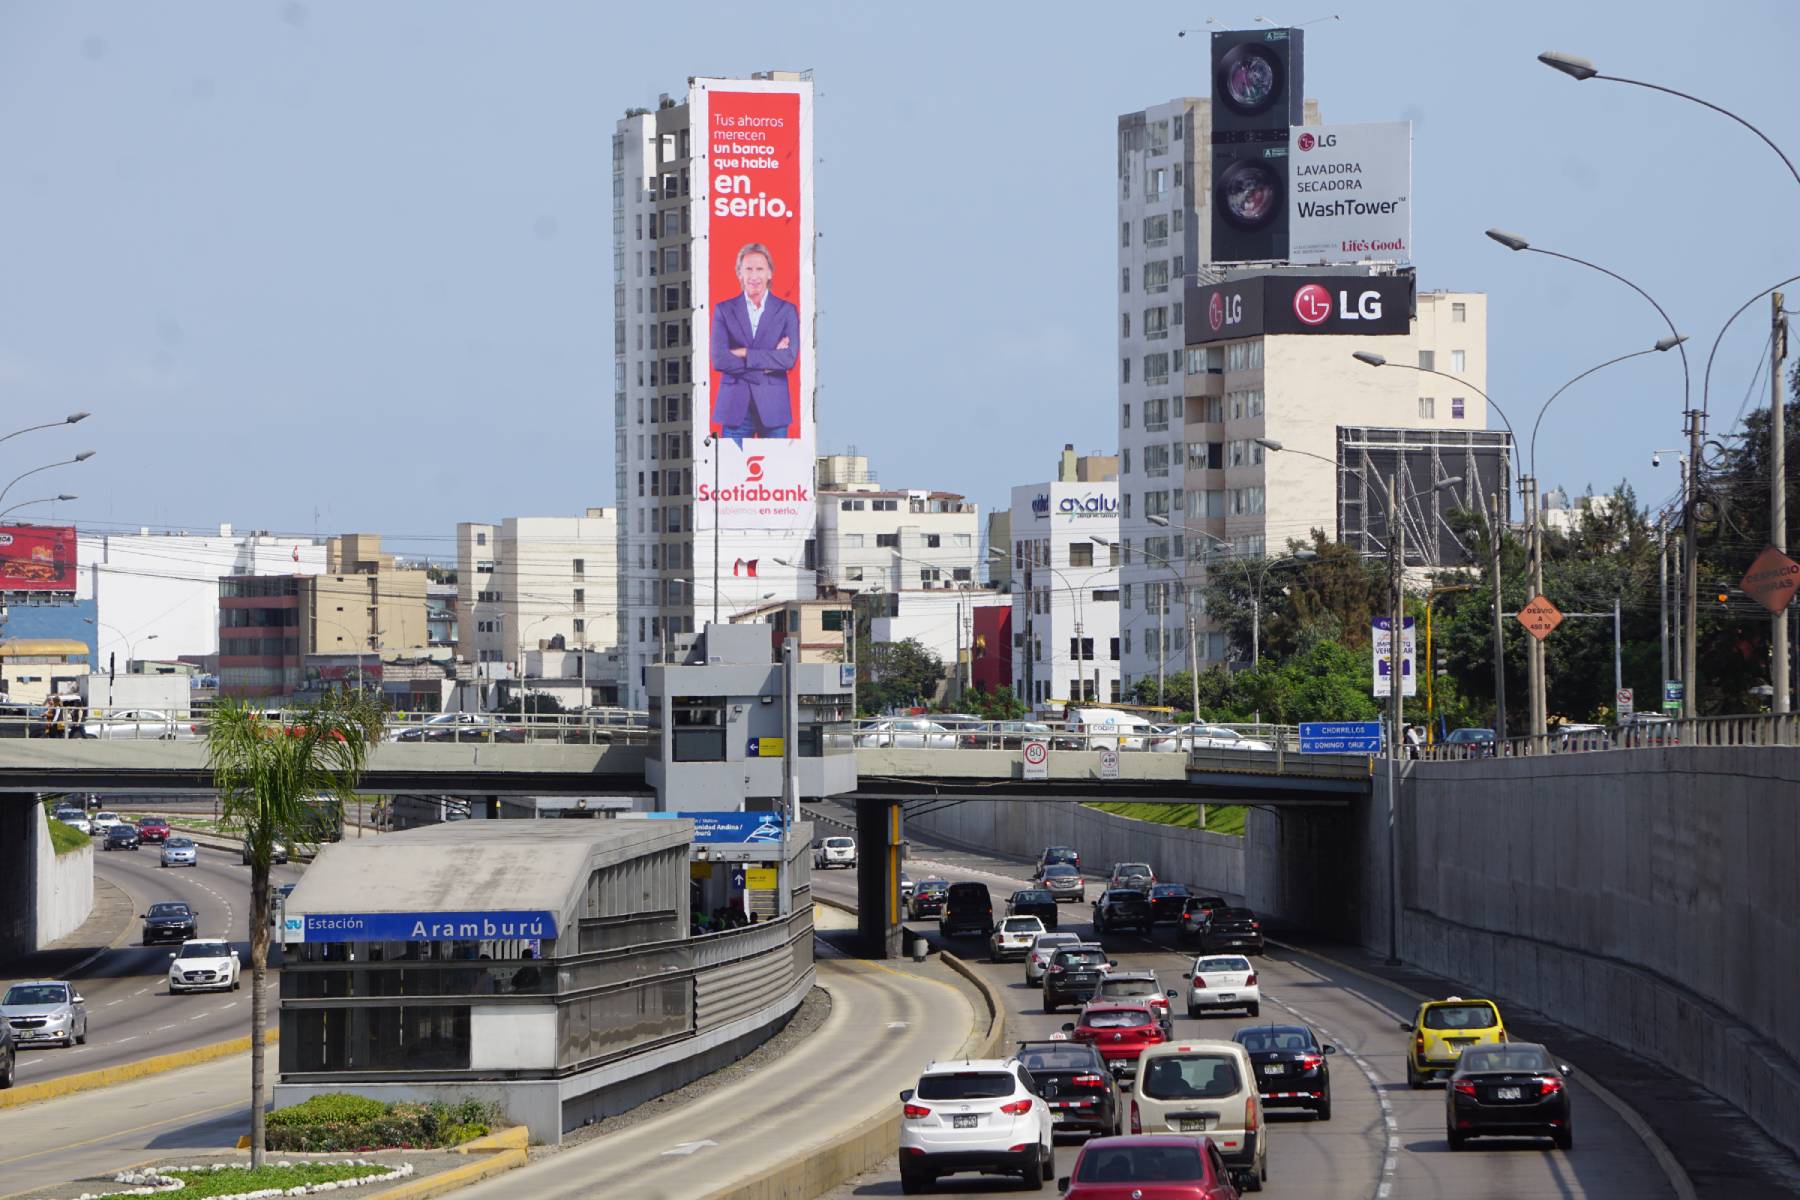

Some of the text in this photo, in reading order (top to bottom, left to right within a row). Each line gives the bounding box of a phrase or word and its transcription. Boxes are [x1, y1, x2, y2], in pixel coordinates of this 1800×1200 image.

[714, 113, 784, 127] Tus ahorros
[713, 130, 766, 141] merecen
[1318, 133, 1337, 148] LG
[713, 142, 775, 155] un banco
[714, 157, 779, 170] que hable
[1297, 163, 1362, 176] LAVADORA
[714, 174, 751, 194] en
[1297, 179, 1363, 193] SECADORA
[714, 192, 793, 218] serio.
[1370, 238, 1406, 251] Good.
[1225, 294, 1242, 325] LG
[1339, 290, 1382, 320] LG
[698, 484, 808, 502] Scotiabank
[759, 507, 771, 515] en
[1321, 726, 1366, 735] CHORRILLOS
[1029, 747, 1042, 757] 80
[308, 916, 364, 930] Estación
[412, 917, 543, 938] Aramburú
